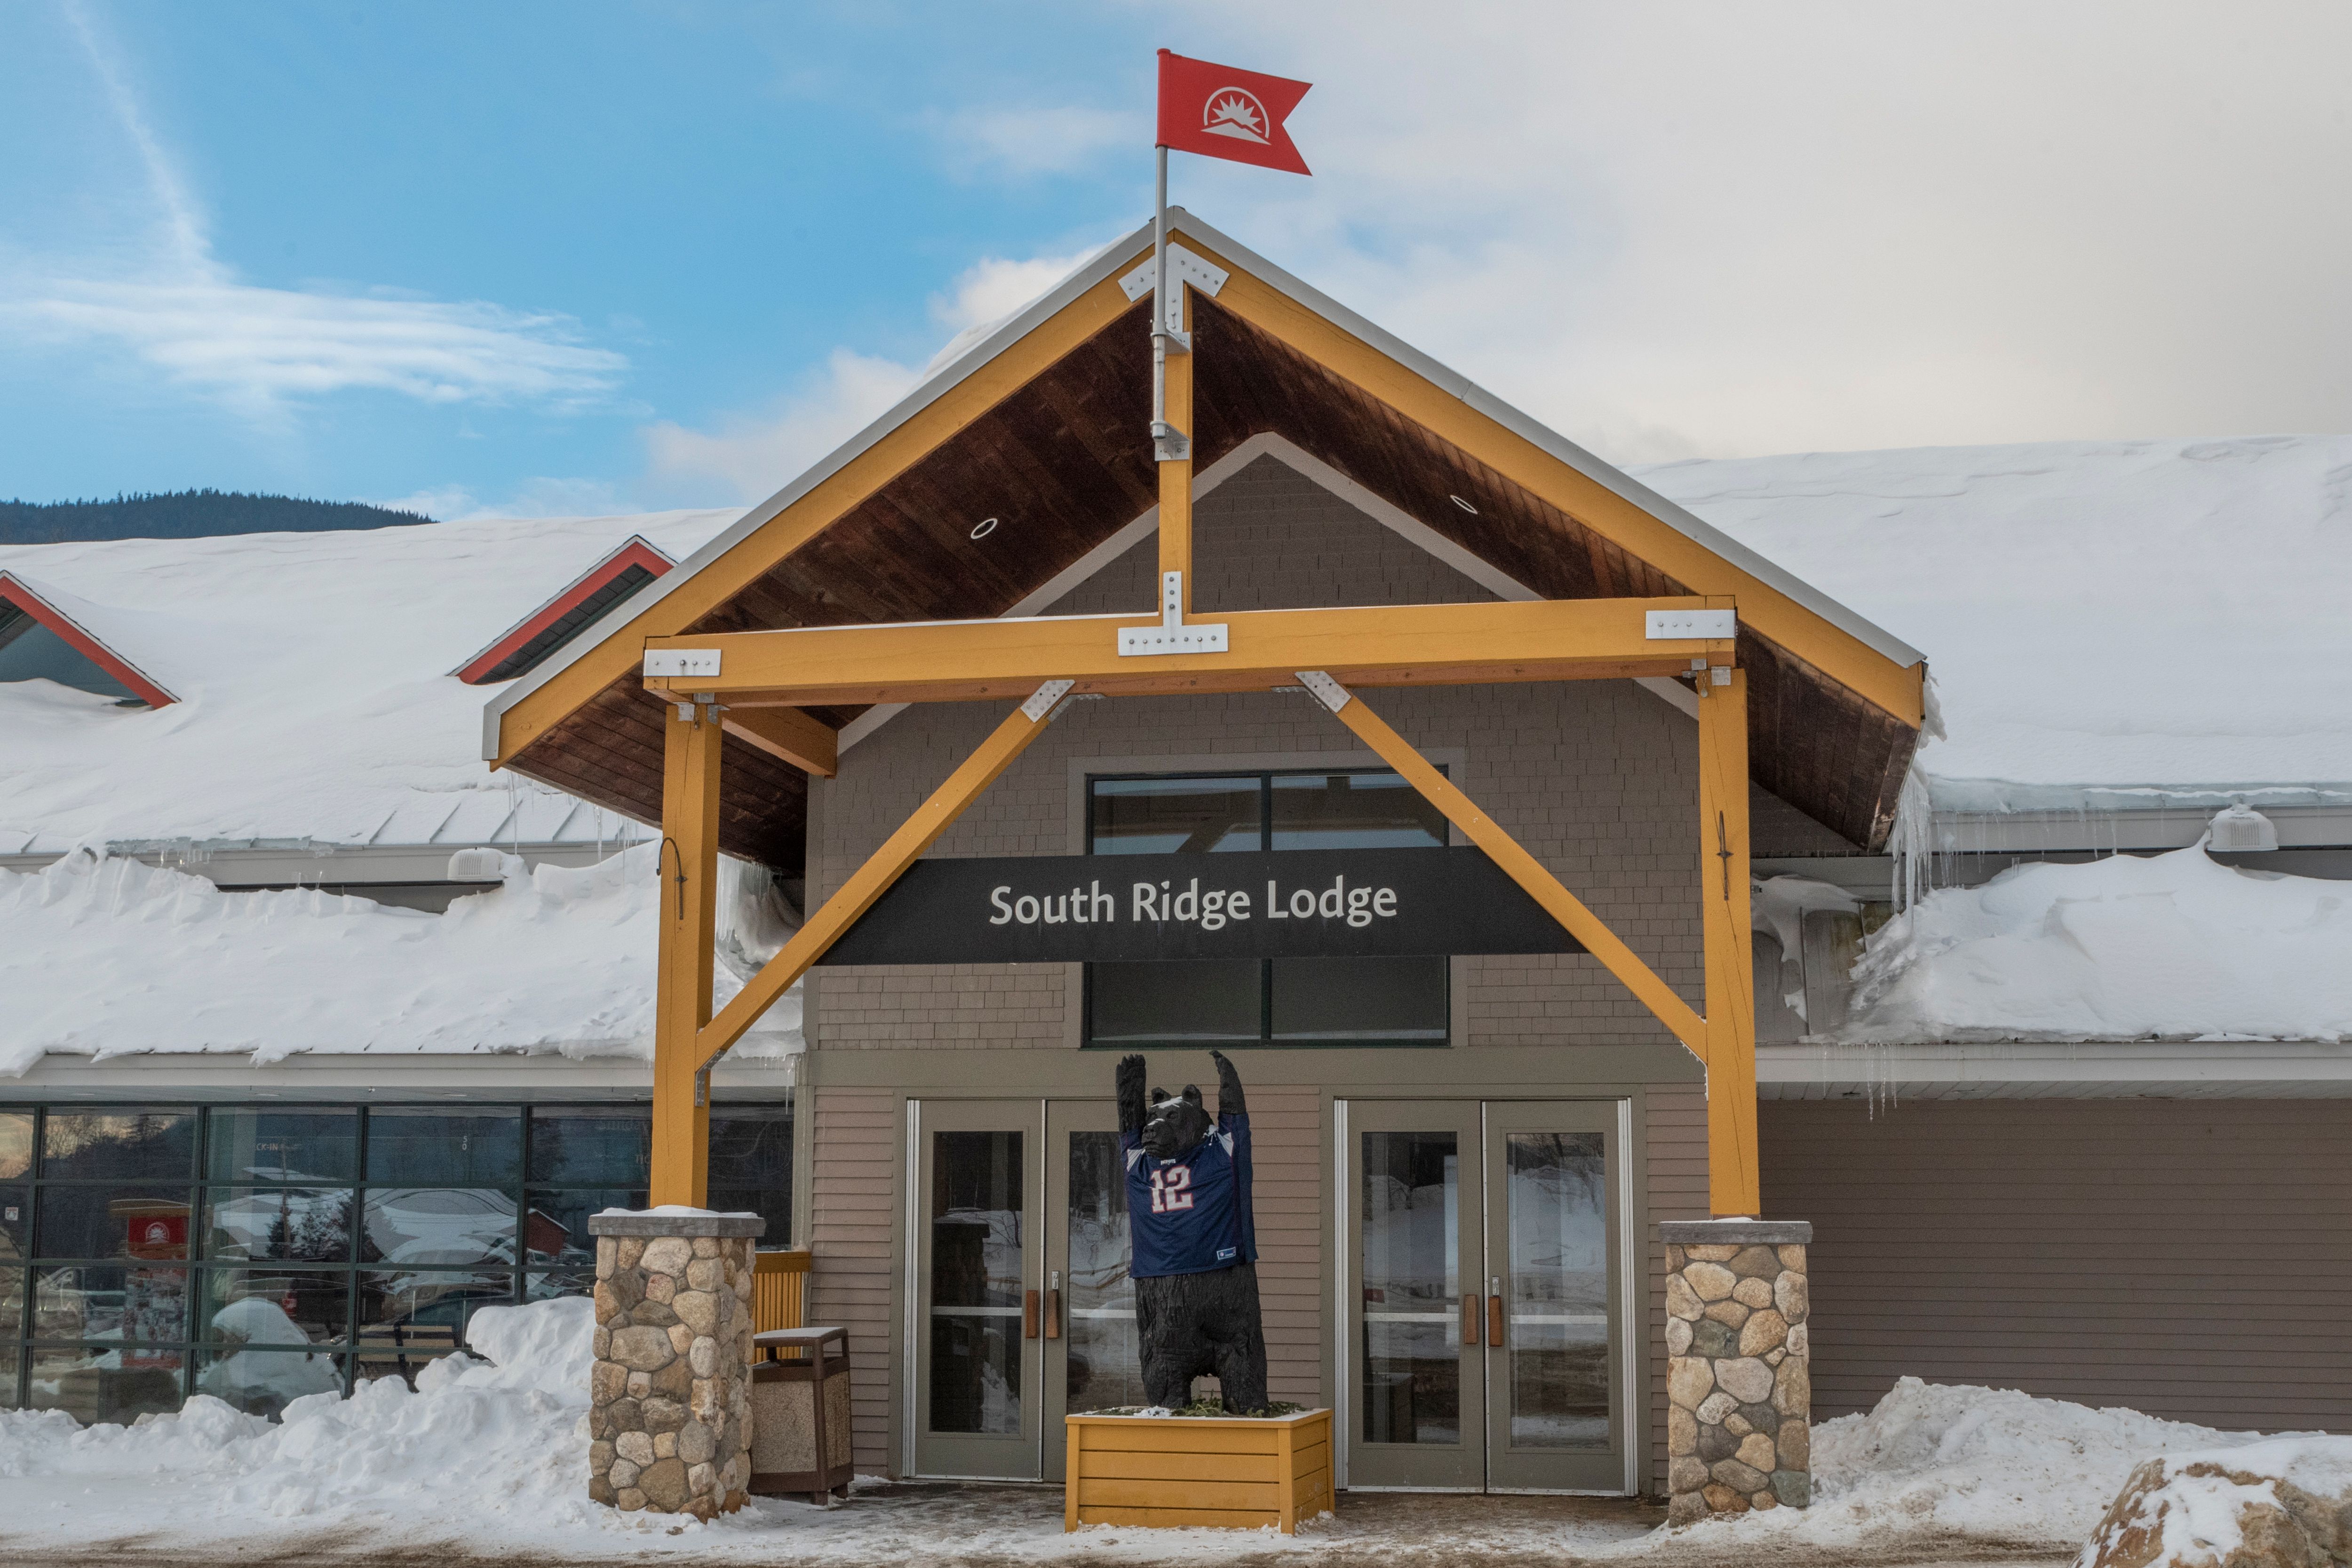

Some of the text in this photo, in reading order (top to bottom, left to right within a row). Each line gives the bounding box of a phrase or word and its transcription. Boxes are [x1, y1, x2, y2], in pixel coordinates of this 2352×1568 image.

[989, 875, 1397, 931] South Ridge Lodge
[1151, 1165, 1193, 1213] 12
